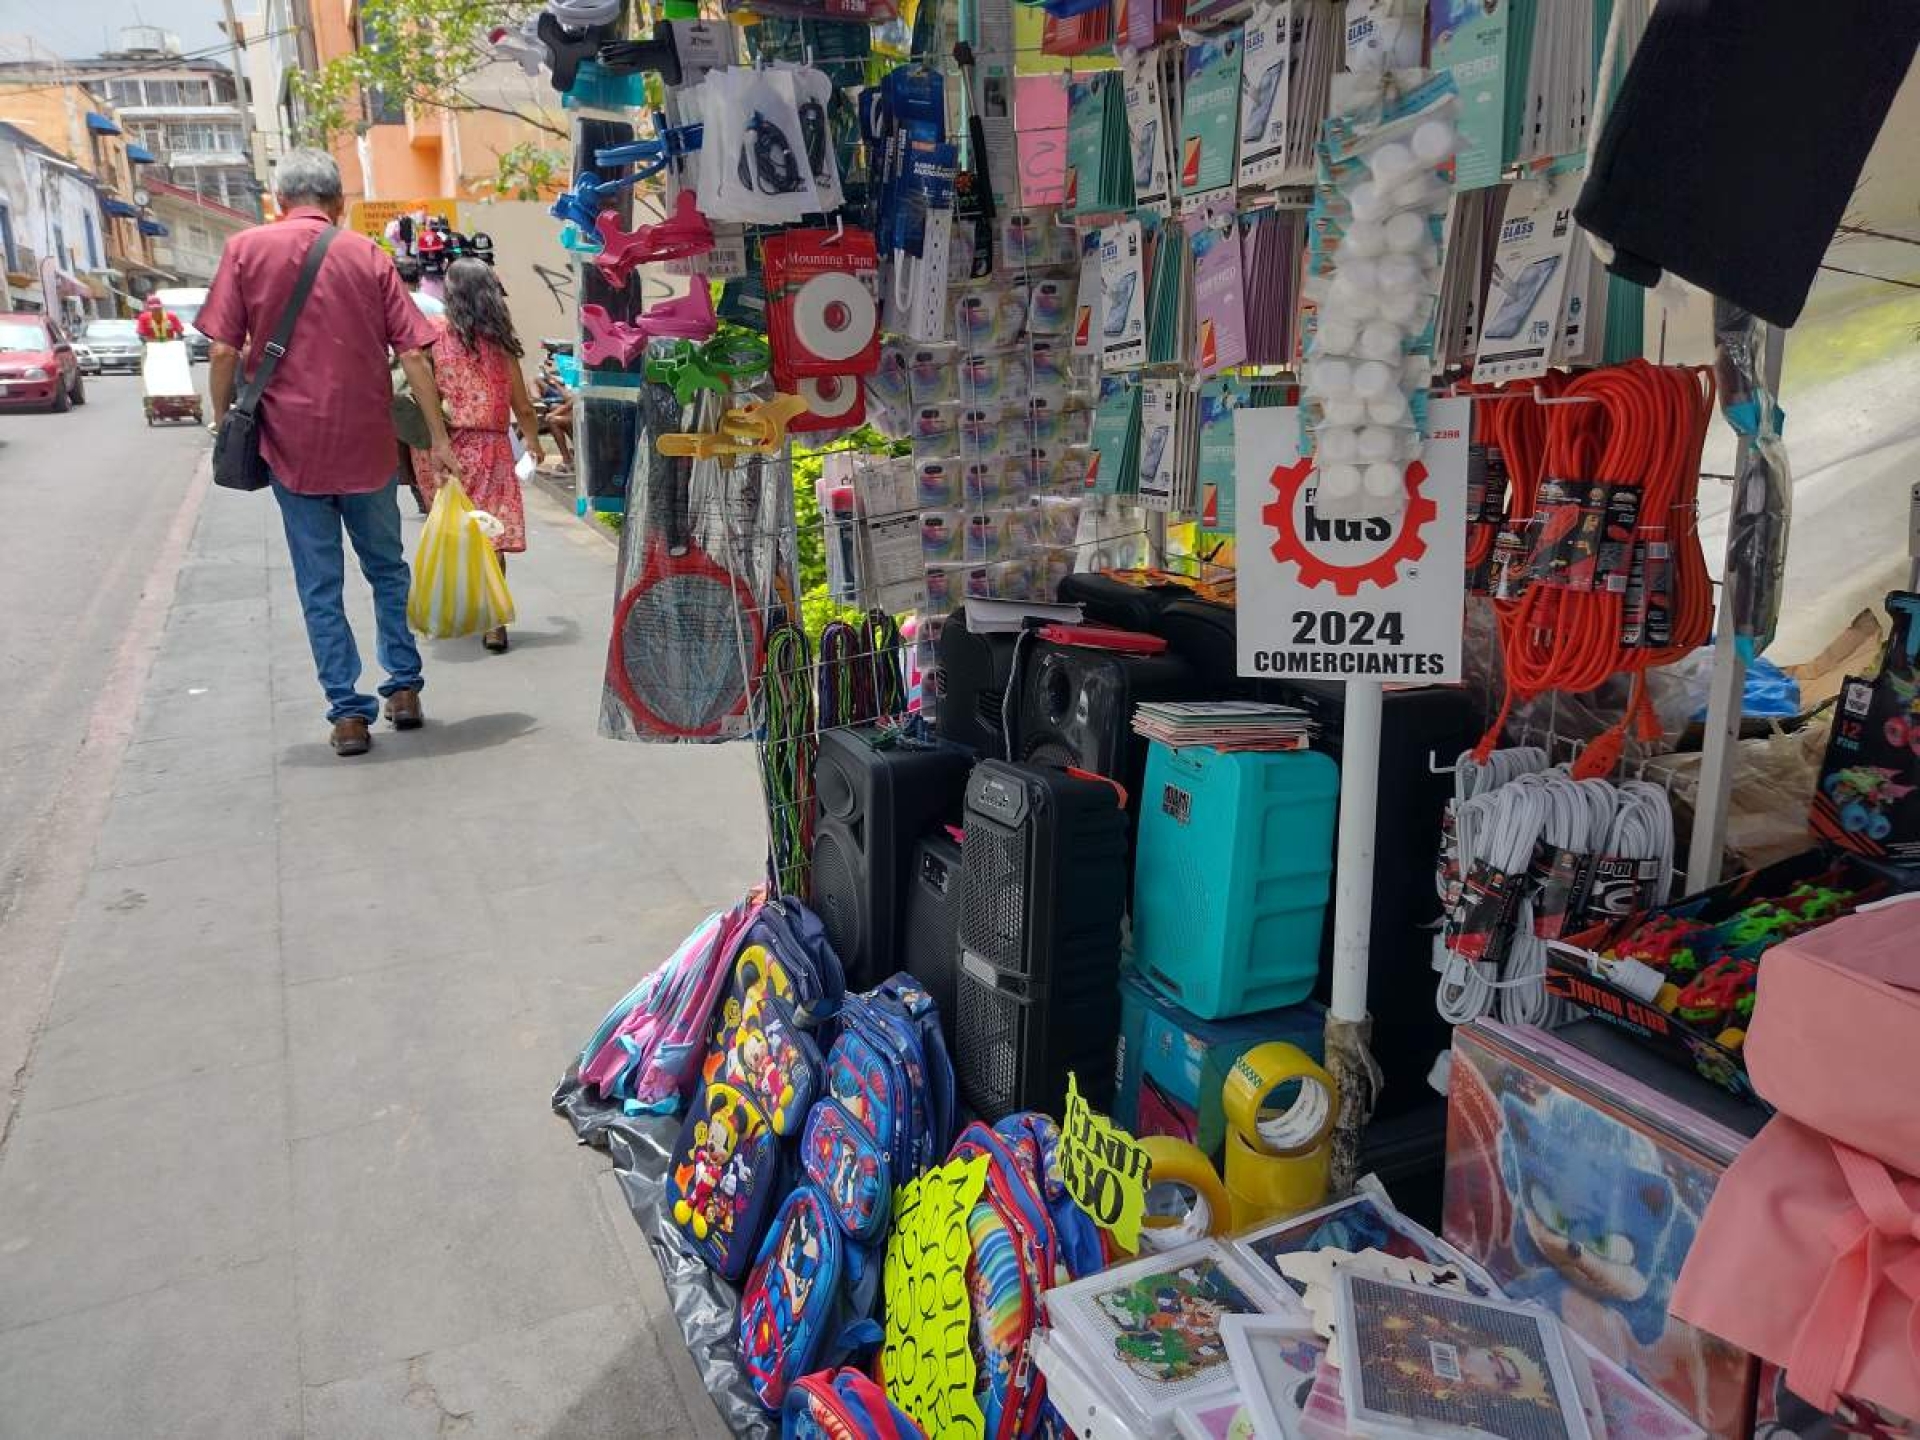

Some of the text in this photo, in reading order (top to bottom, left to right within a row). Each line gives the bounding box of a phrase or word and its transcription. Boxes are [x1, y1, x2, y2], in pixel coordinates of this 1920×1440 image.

[1347, 20, 1374, 41] GLASS
[1502, 221, 1535, 239] GLASS
[787, 252, 844, 267] Mounting
[845, 254, 873, 267] Tape
[1292, 611, 1404, 646] 2024
[1254, 651, 1444, 675] COMERCIANTES
